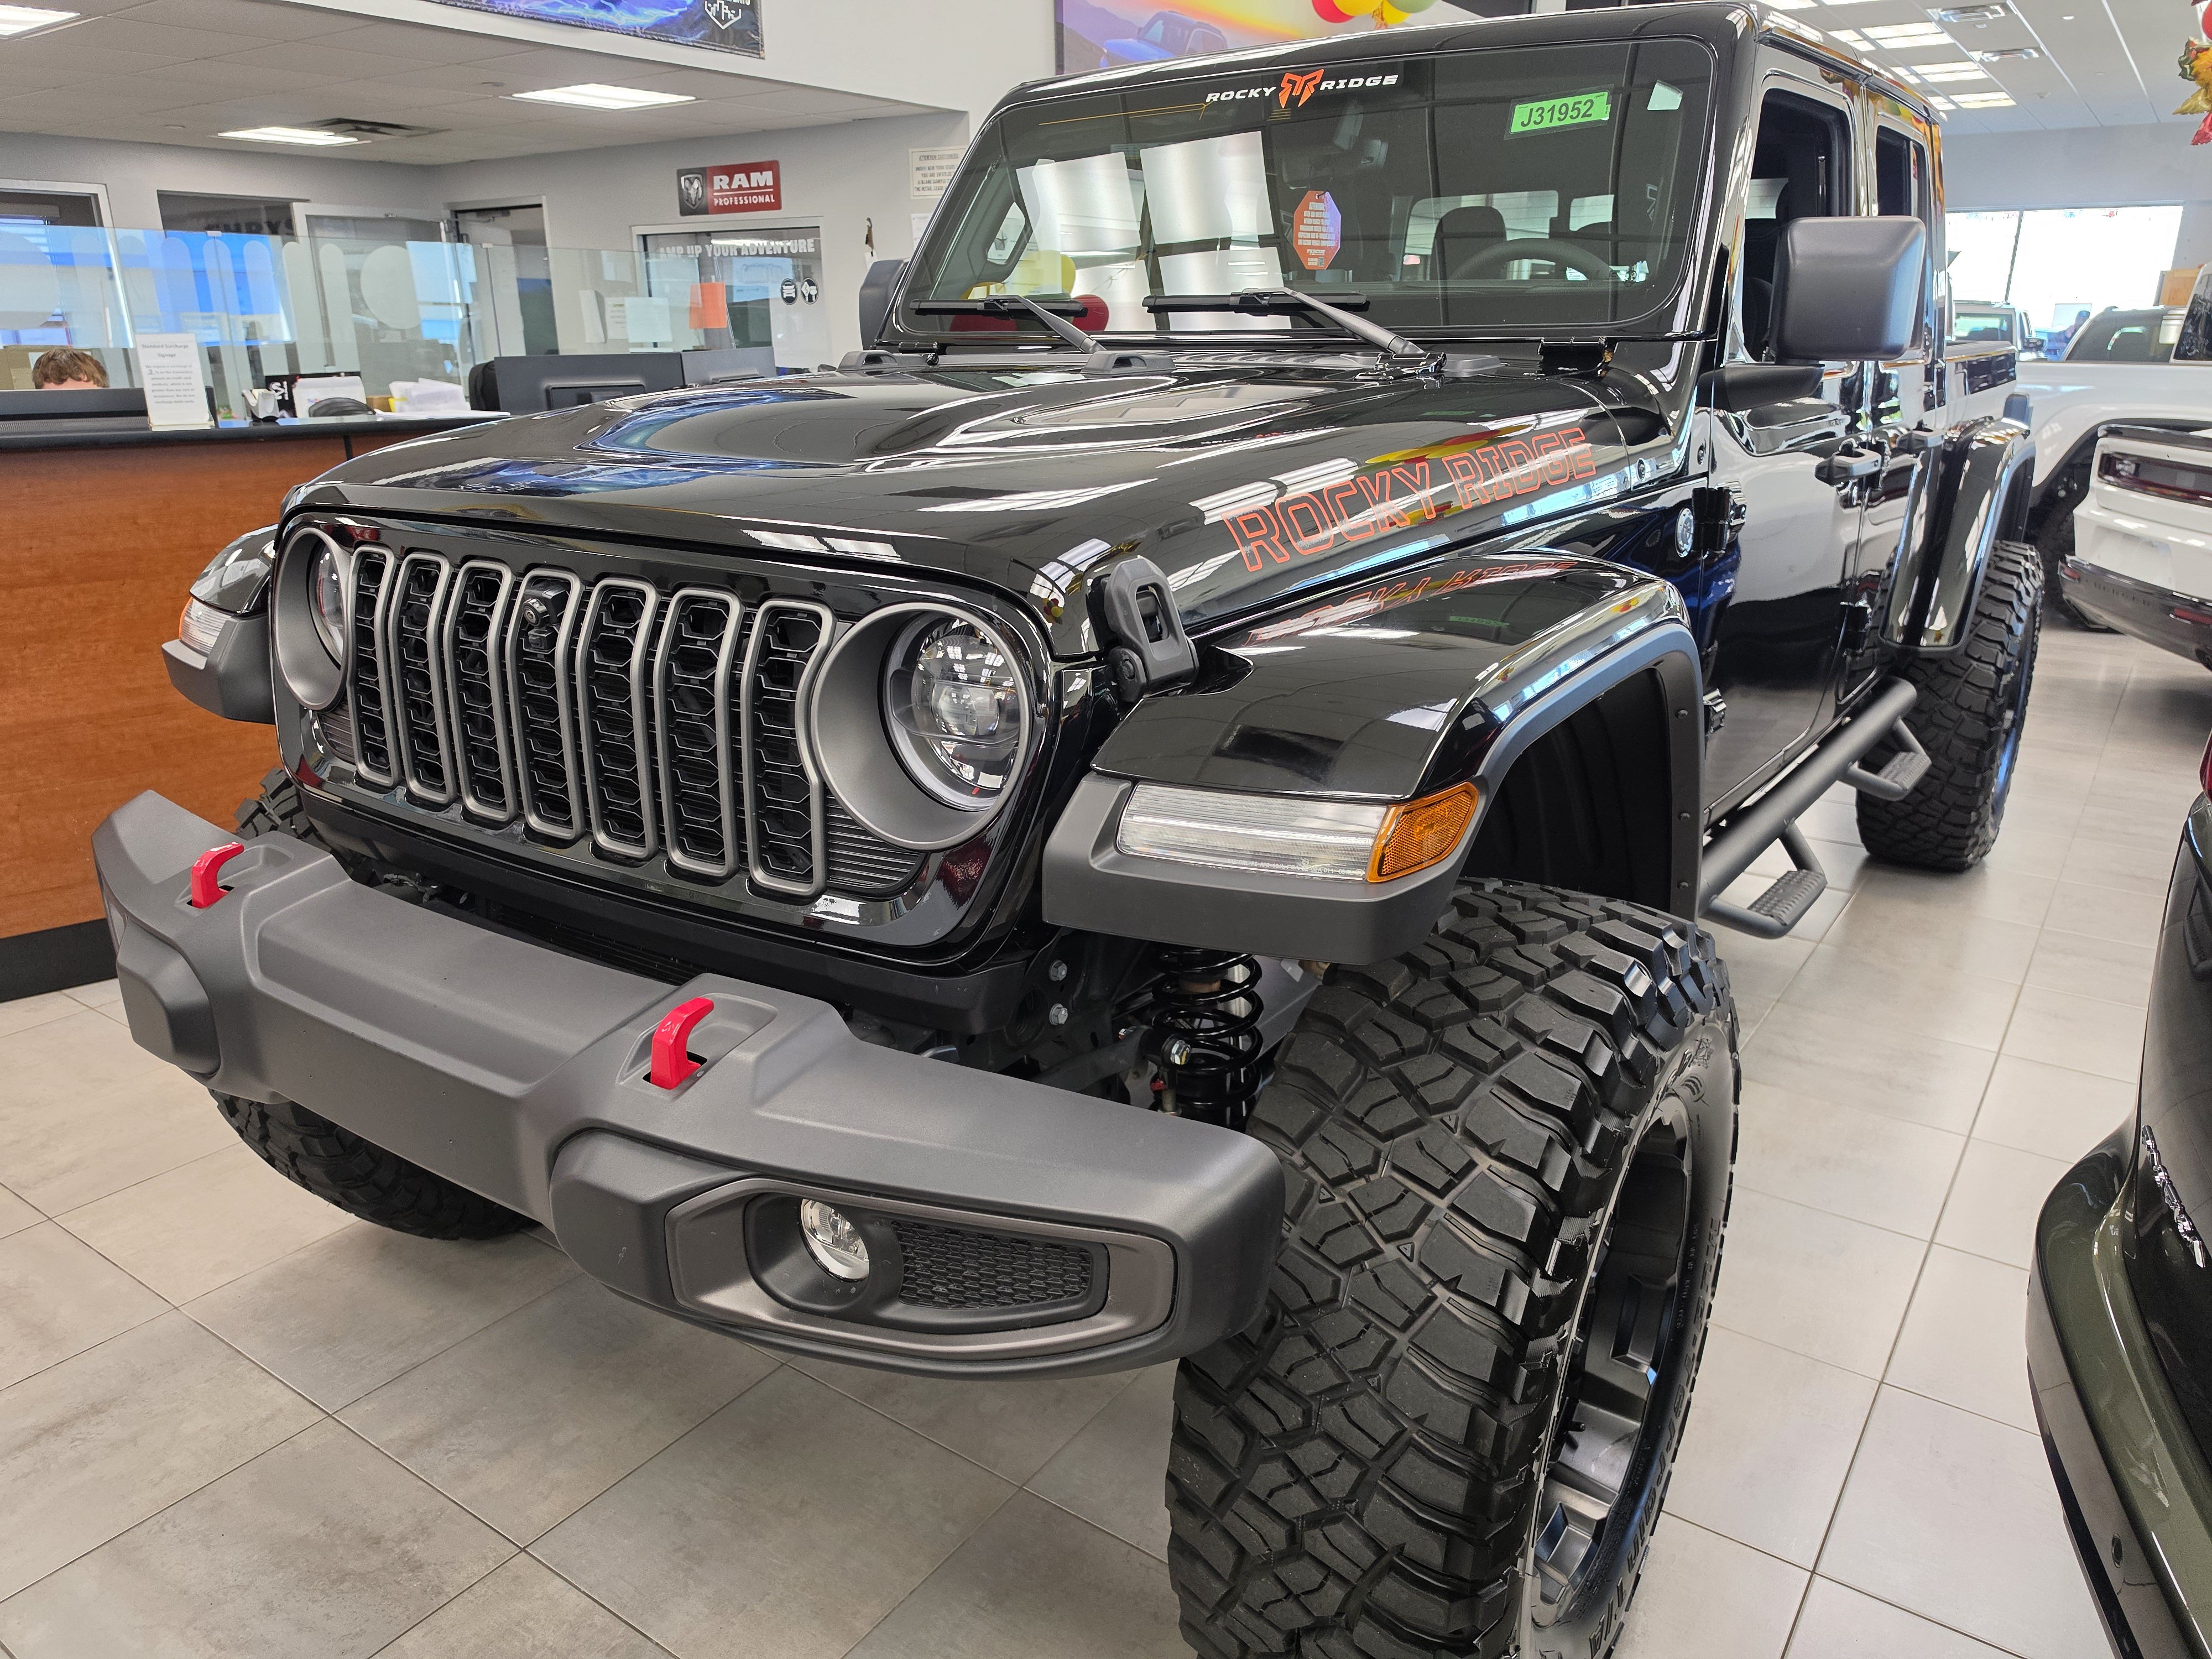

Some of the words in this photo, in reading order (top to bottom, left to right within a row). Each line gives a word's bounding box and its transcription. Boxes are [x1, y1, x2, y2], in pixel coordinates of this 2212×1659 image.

[1206, 86, 1276, 103] ROCKY
[1320, 74, 1399, 91] RIDGE
[1521, 99, 1594, 127] J31952
[713, 171, 773, 190] RAM
[713, 194, 775, 206] PROFESSIONAL
[706, 244, 739, 257] YOUR
[741, 238, 816, 256] ADVENTURE
[1221, 461, 1437, 572] ROCKY
[1442, 427, 1597, 510] RIDGE
